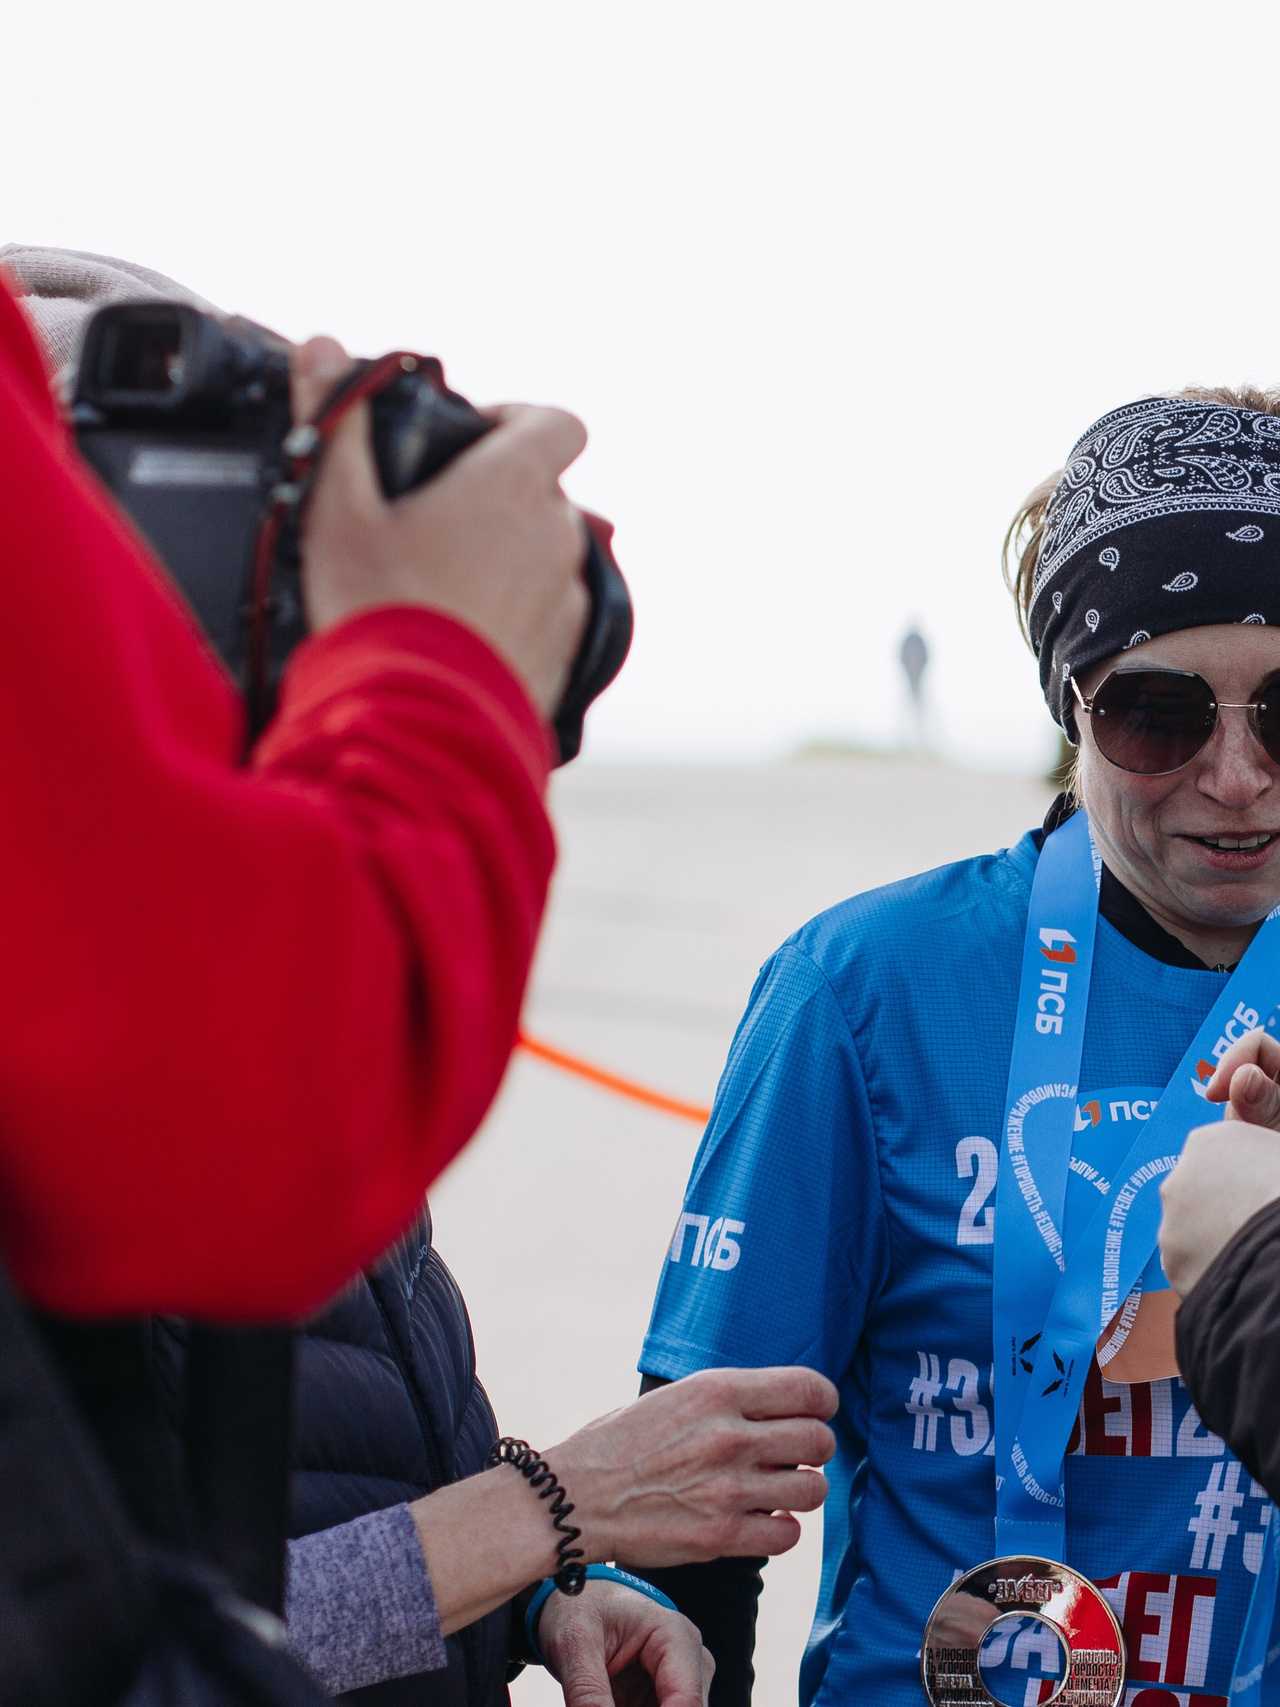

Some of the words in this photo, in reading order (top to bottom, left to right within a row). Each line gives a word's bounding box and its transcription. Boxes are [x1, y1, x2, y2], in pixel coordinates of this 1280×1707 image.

[1035, 969, 1068, 1035] ПСБ
[1007, 1083, 1078, 1154] #САМОВЫРАЖЕНИЕ
[1109, 1100, 1160, 1122] ПС
[1010, 1154, 1044, 1214] #ГОРДОСТЬ
[1129, 1155, 1182, 1189] #УДИВЛЕ
[1109, 1183, 1140, 1229] #ТРЕПЕТ
[669, 1212, 746, 1272] ПСБ
[1103, 1228, 1124, 1289] #ВОЛНЕНИЕ
[1075, 1678, 1110, 1691] #МЕЧТА
